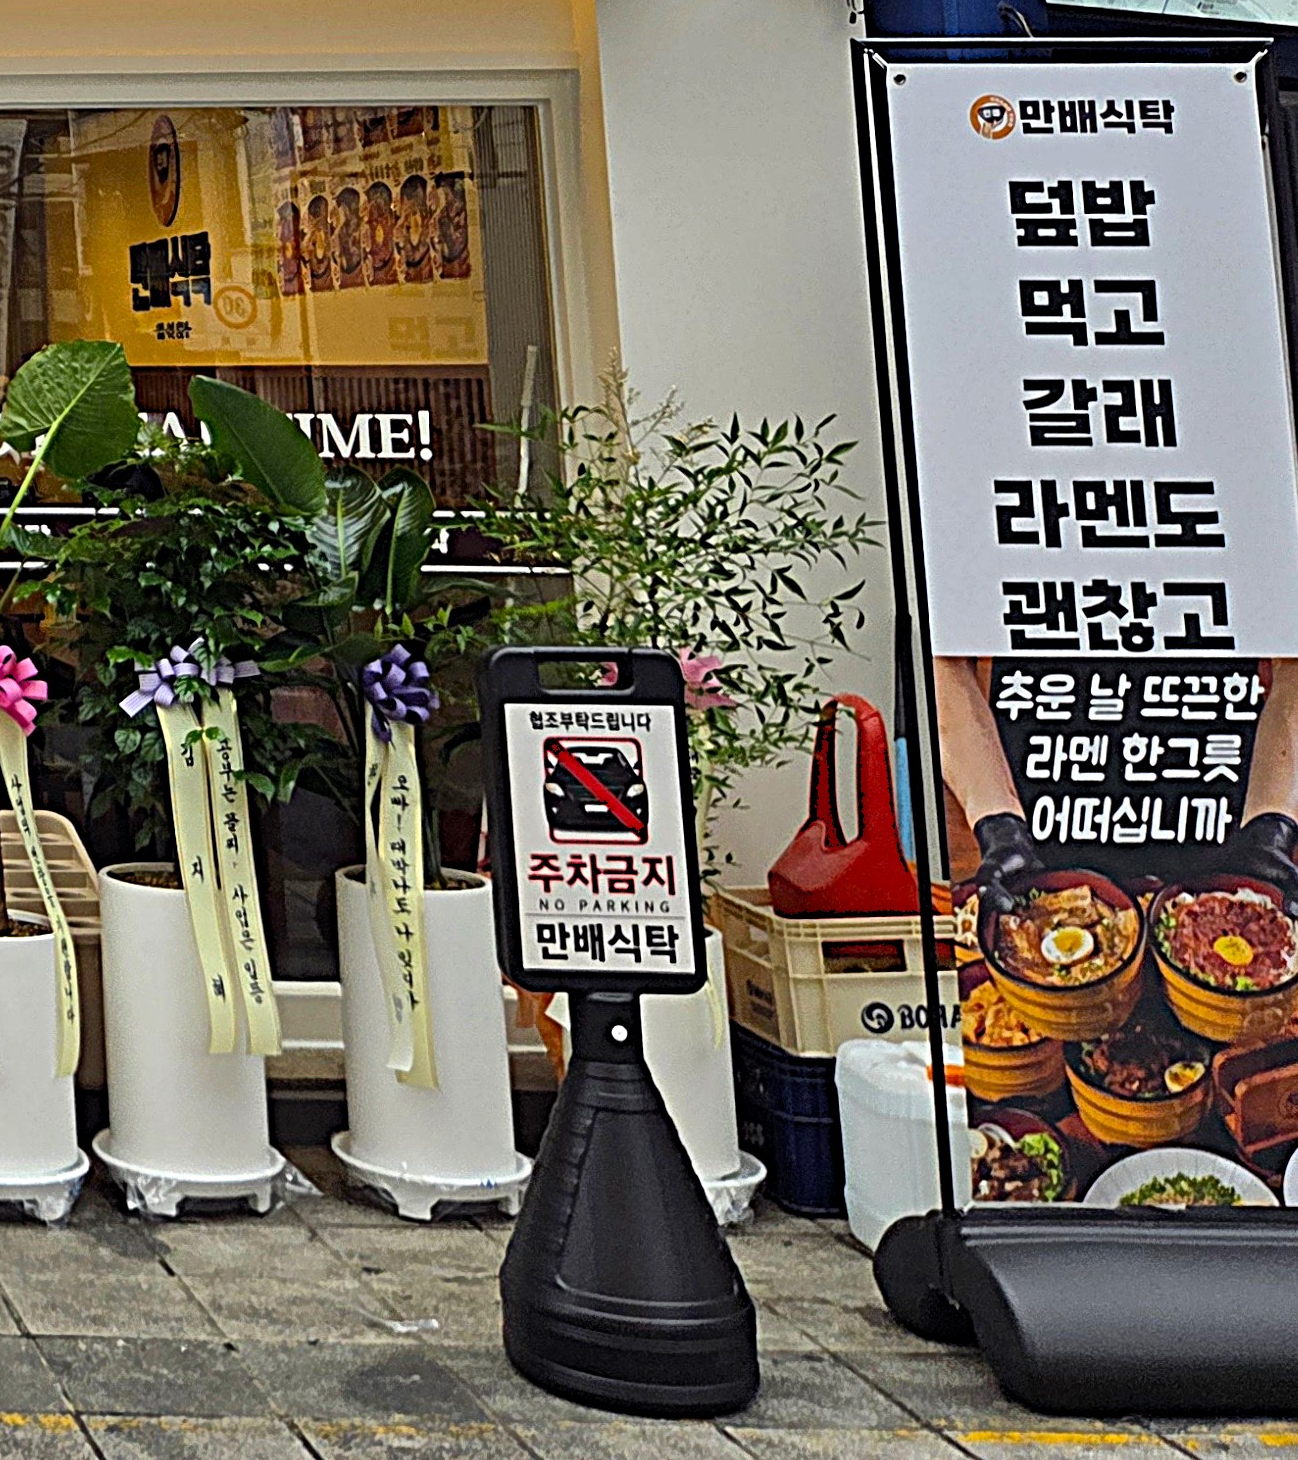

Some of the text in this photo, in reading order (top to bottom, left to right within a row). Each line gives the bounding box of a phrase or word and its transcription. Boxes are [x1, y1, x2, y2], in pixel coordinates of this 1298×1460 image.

[1018, 99, 1174, 134] 만배식탁
[1009, 179, 1155, 247] 덮밥
[1018, 279, 1165, 346] 먹고
[1023, 379, 1177, 447] 갈래
[994, 480, 1225, 548] 라멘도
[1003, 579, 1234, 651] 괜찮고
[996, 671, 1264, 721] 추운 날 뜨끈한
[529, 711, 651, 732] 협조부탁드립니다
[1025, 734, 1242, 782] 라멘 한그릇
[1032, 794, 1233, 844] 어떠십니까
[528, 853, 676, 896] 주차금지
[540, 899, 670, 913] NO PARKING
[537, 923, 679, 964] 만배식탁
